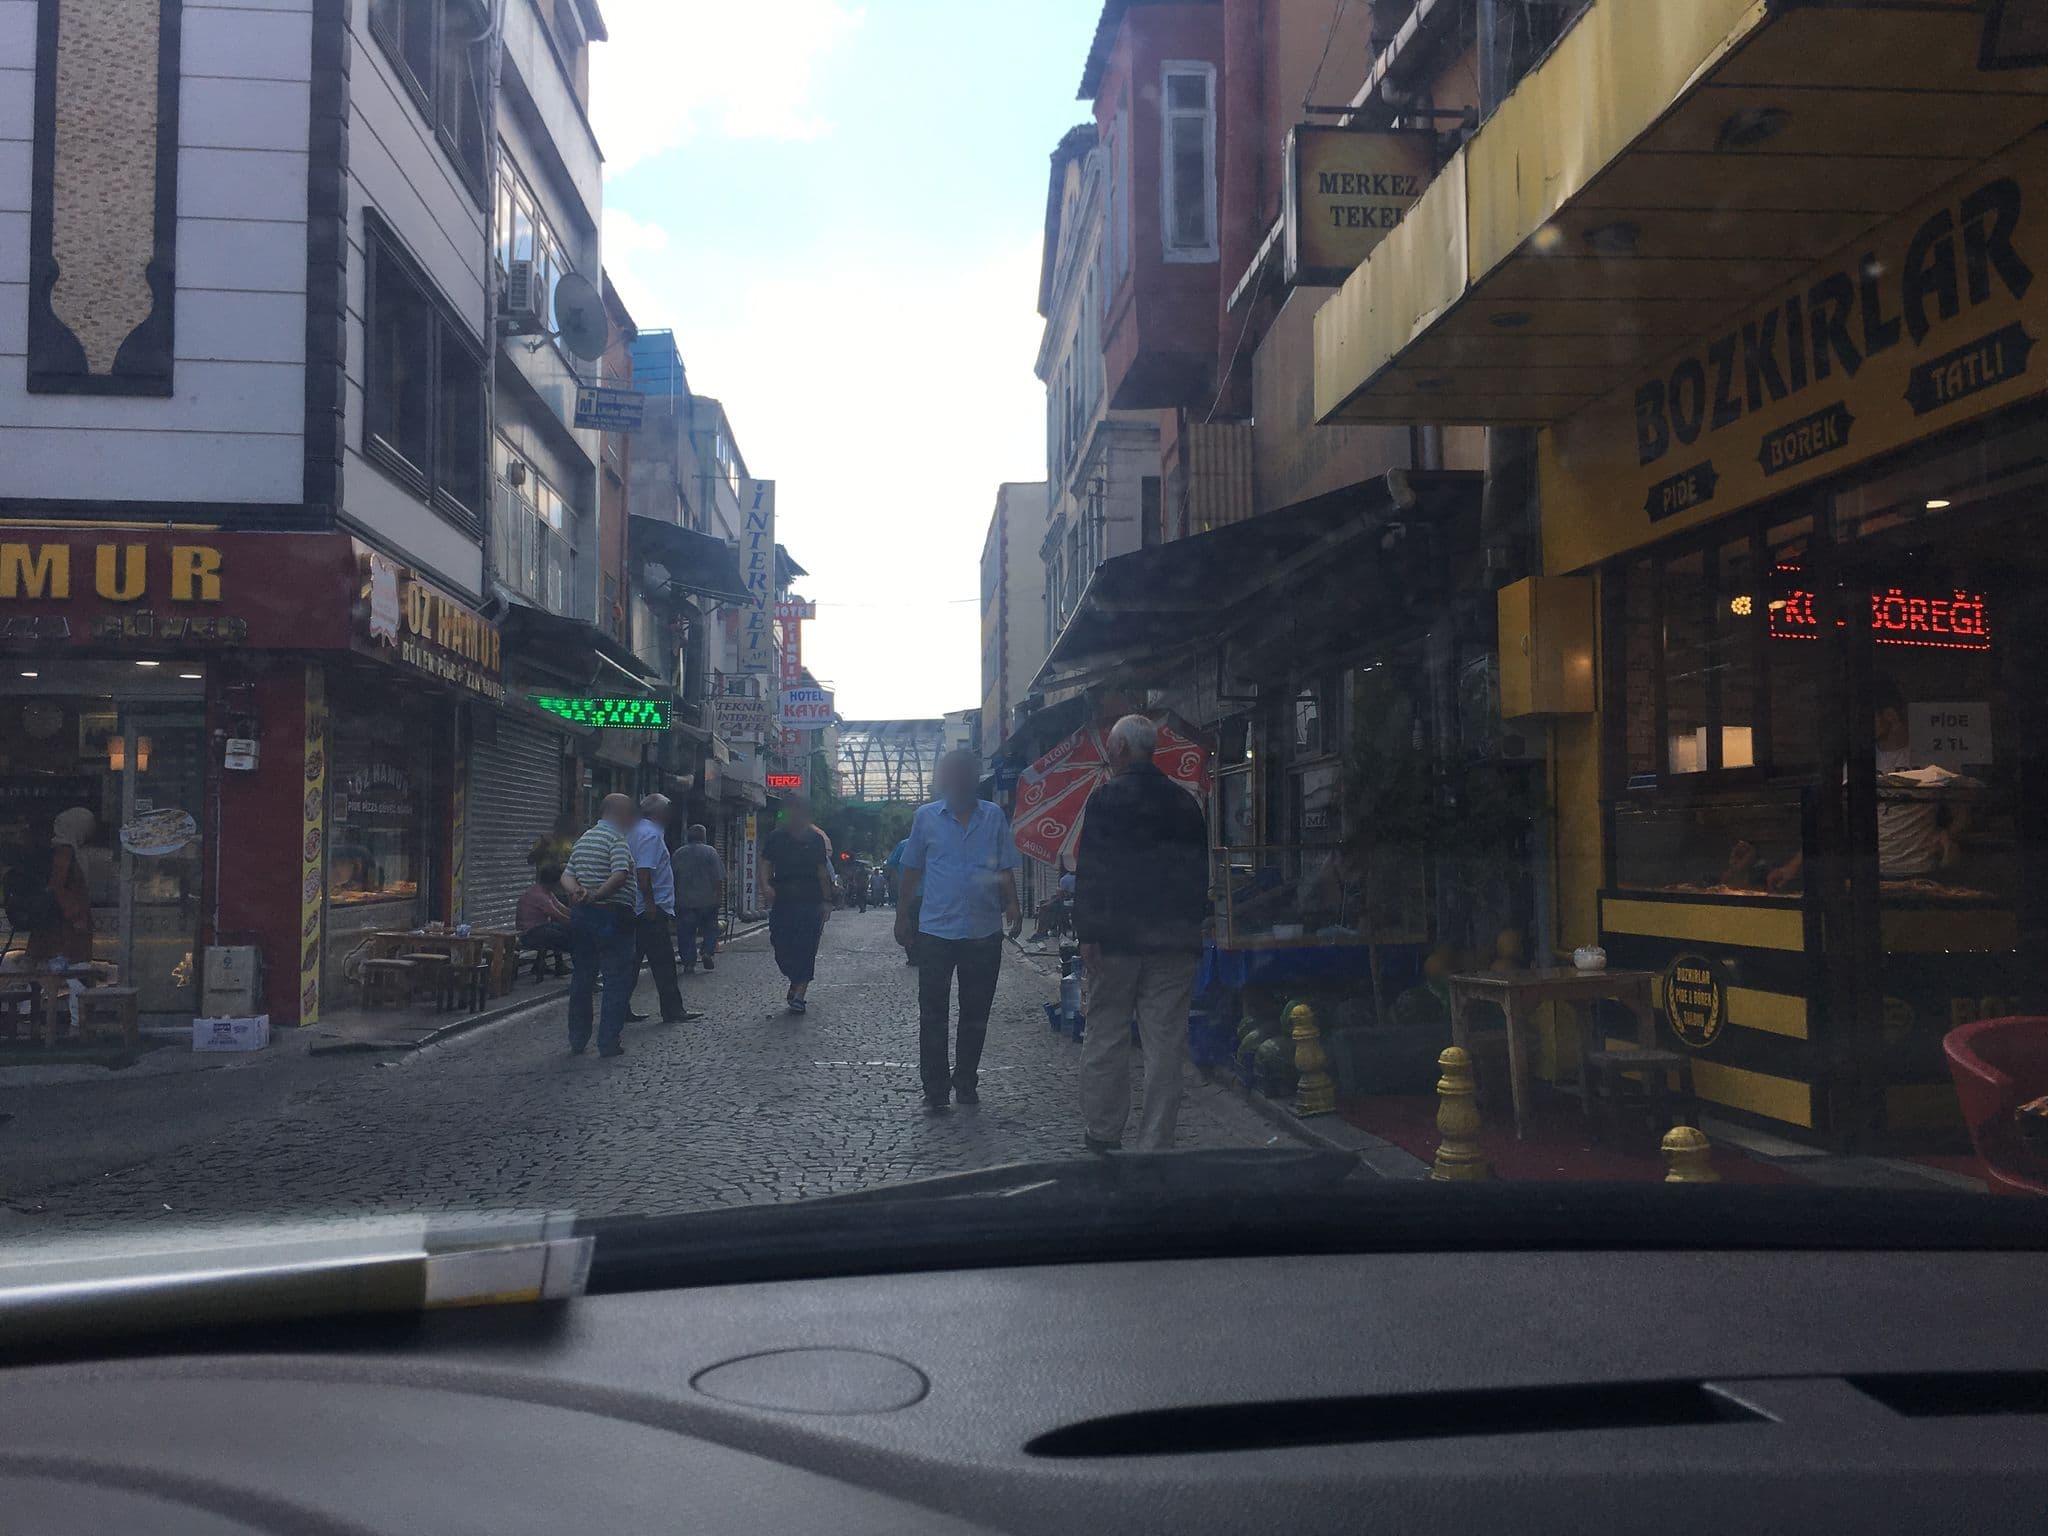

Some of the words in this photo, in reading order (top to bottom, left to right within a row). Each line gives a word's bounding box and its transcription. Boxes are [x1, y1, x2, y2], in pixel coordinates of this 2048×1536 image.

[1318, 172, 1420, 197] MERKEZ
[1634, 177, 2035, 467] BOZKIRLAR
[790, 691, 823, 701] HOTEL
[784, 704, 830, 718] KAYA
